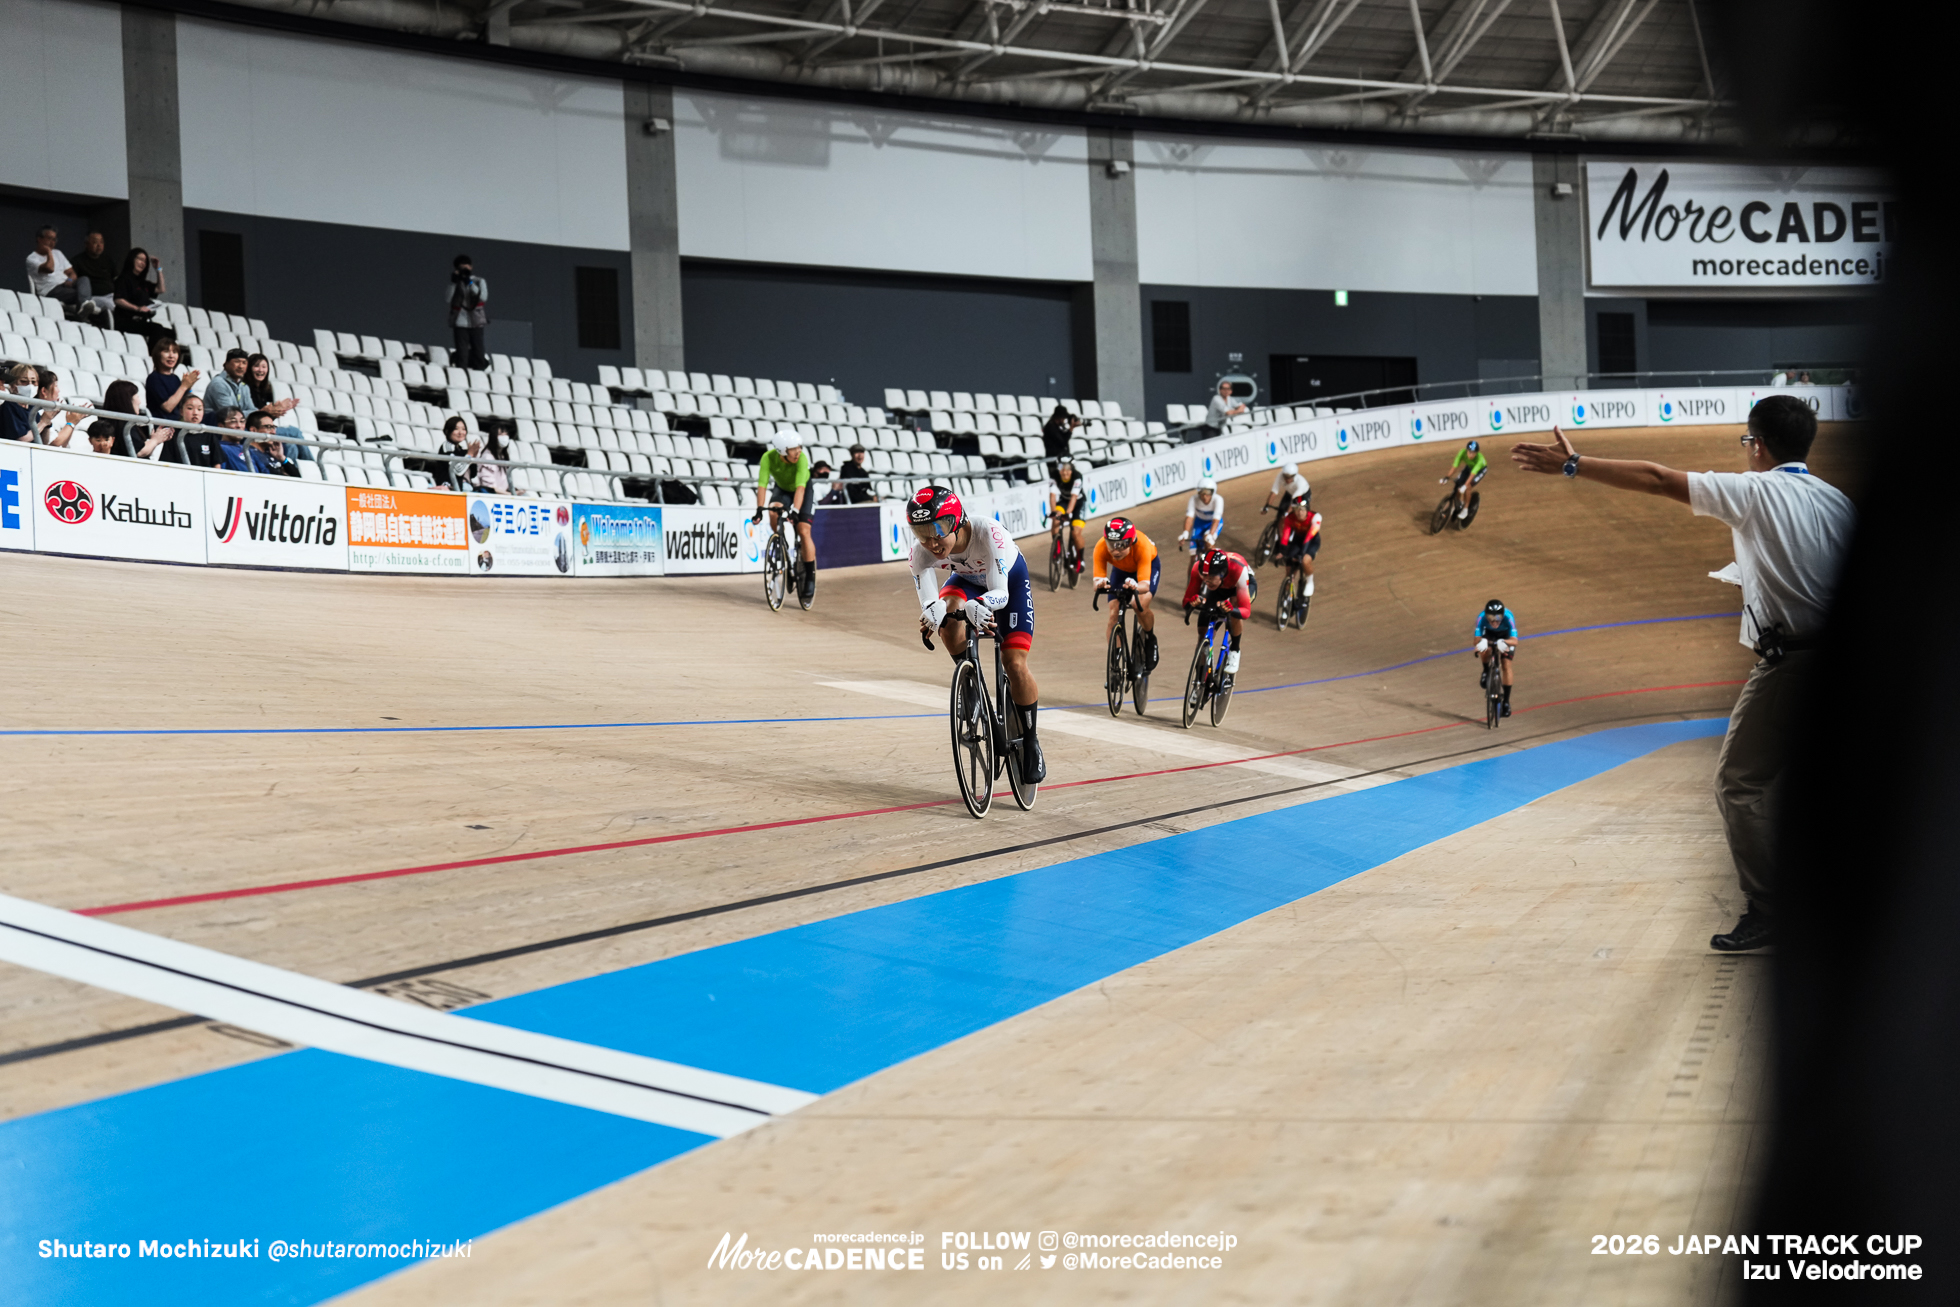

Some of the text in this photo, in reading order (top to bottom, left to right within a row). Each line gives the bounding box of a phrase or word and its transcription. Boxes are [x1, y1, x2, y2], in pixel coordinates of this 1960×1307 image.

[1597, 167, 1893, 243] MoreCADE
[1692, 252, 1884, 280] morecadence.j
[1507, 404, 1550, 425] NIPPO
[1590, 401, 1636, 420] NIPPO
[1678, 398, 1725, 417] NIPPO
[1351, 420, 1391, 443] NIPPO
[1427, 411, 1469, 433] NIPPO
[1280, 431, 1317, 456] NIPPO
[1214, 444, 1250, 471] NIPPO
[1154, 460, 1186, 488] NIPPO
[350, 492, 398, 510] 一般社団法人
[1099, 477, 1128, 504] NIPPO
[101, 493, 192, 529] Kabuto
[245, 499, 337, 546] vittoria
[1002, 508, 1028, 535] NIPPO
[349, 510, 467, 546] 静岡県自転車競技連盟
[591, 514, 634, 546] Welcome
[665, 521, 738, 561] wattbike
[353, 551, 466, 568] http://shizuoka-cf.com/
[1025, 579, 1034, 631] JAPAN
